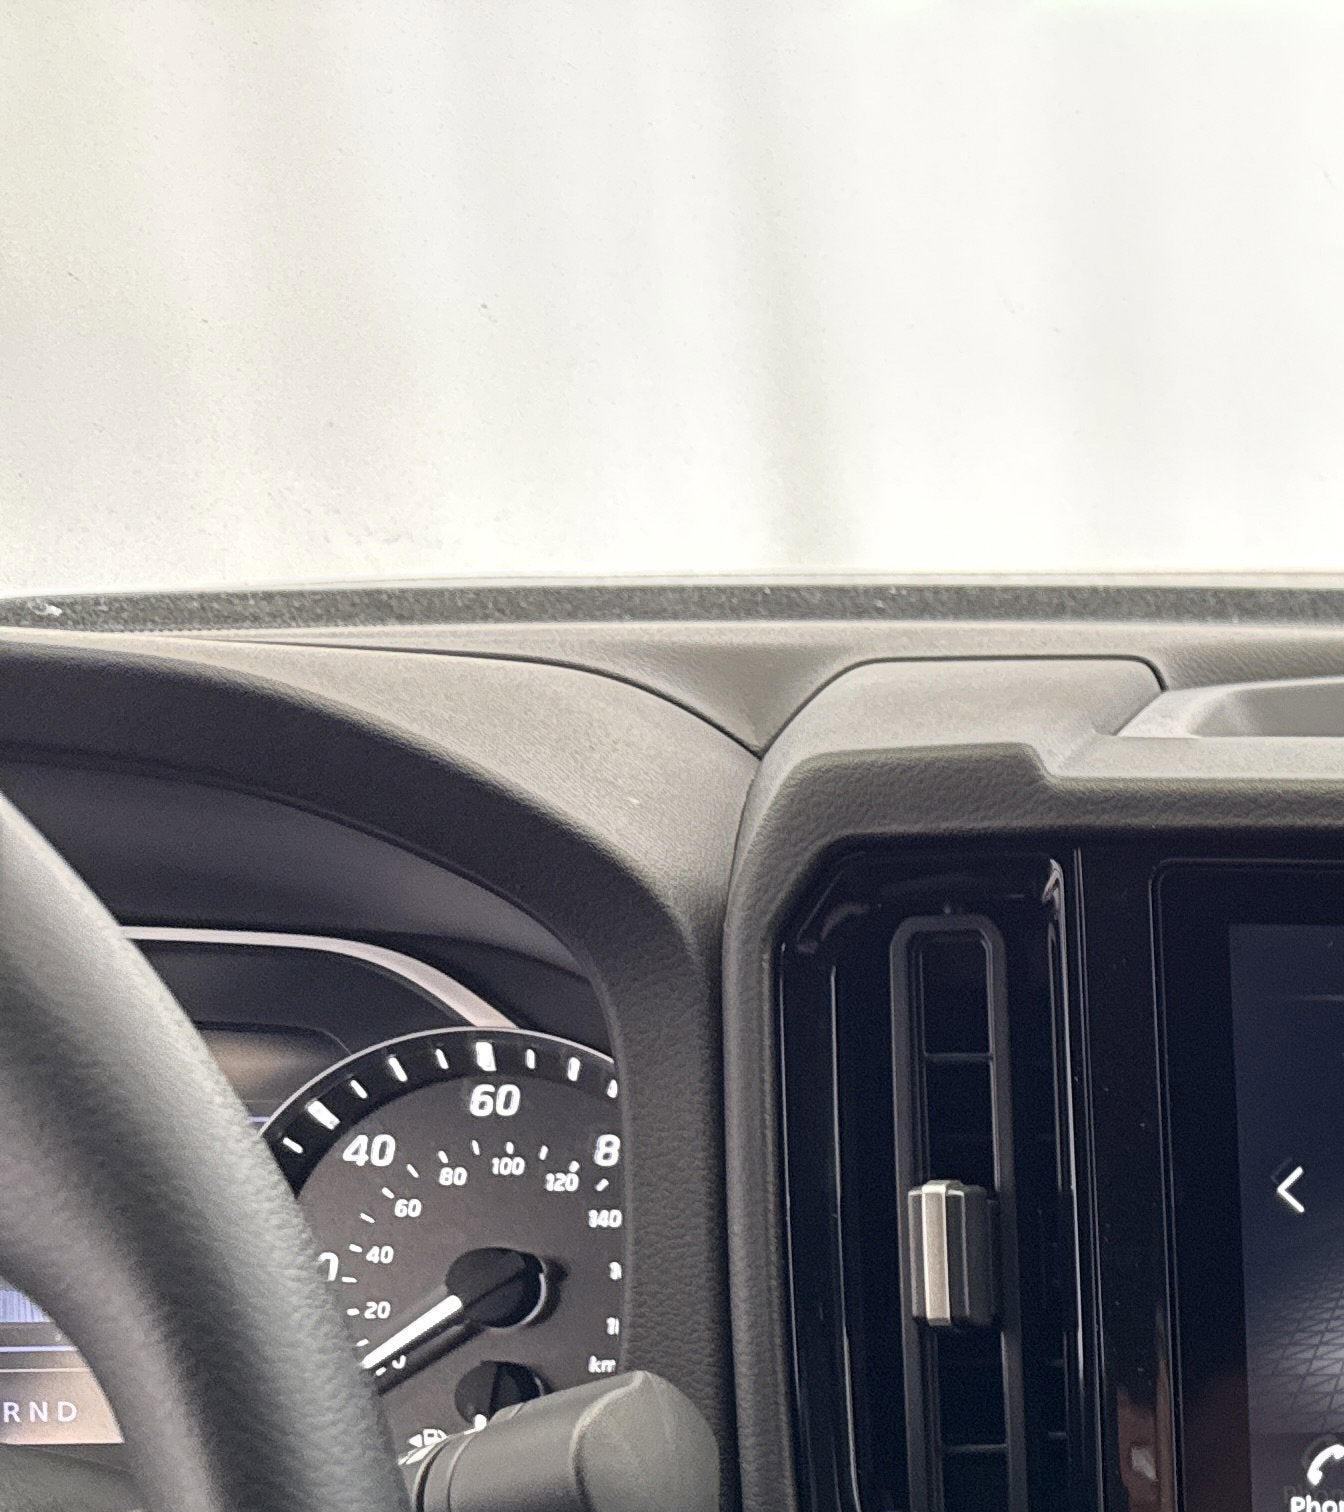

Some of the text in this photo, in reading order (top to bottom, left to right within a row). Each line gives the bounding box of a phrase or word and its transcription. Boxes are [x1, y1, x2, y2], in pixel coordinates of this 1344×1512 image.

[469, 1084, 520, 1116] 60
[343, 1135, 395, 1167] 40
[594, 1134, 620, 1166] 8
[439, 1166, 467, 1186] 80
[491, 1157, 524, 1177] 100
[545, 1173, 579, 1192] 120
[394, 1199, 421, 1218] 60
[588, 1209, 622, 1228] 140
[366, 1246, 394, 1264] 40
[364, 1302, 390, 1319] 20
